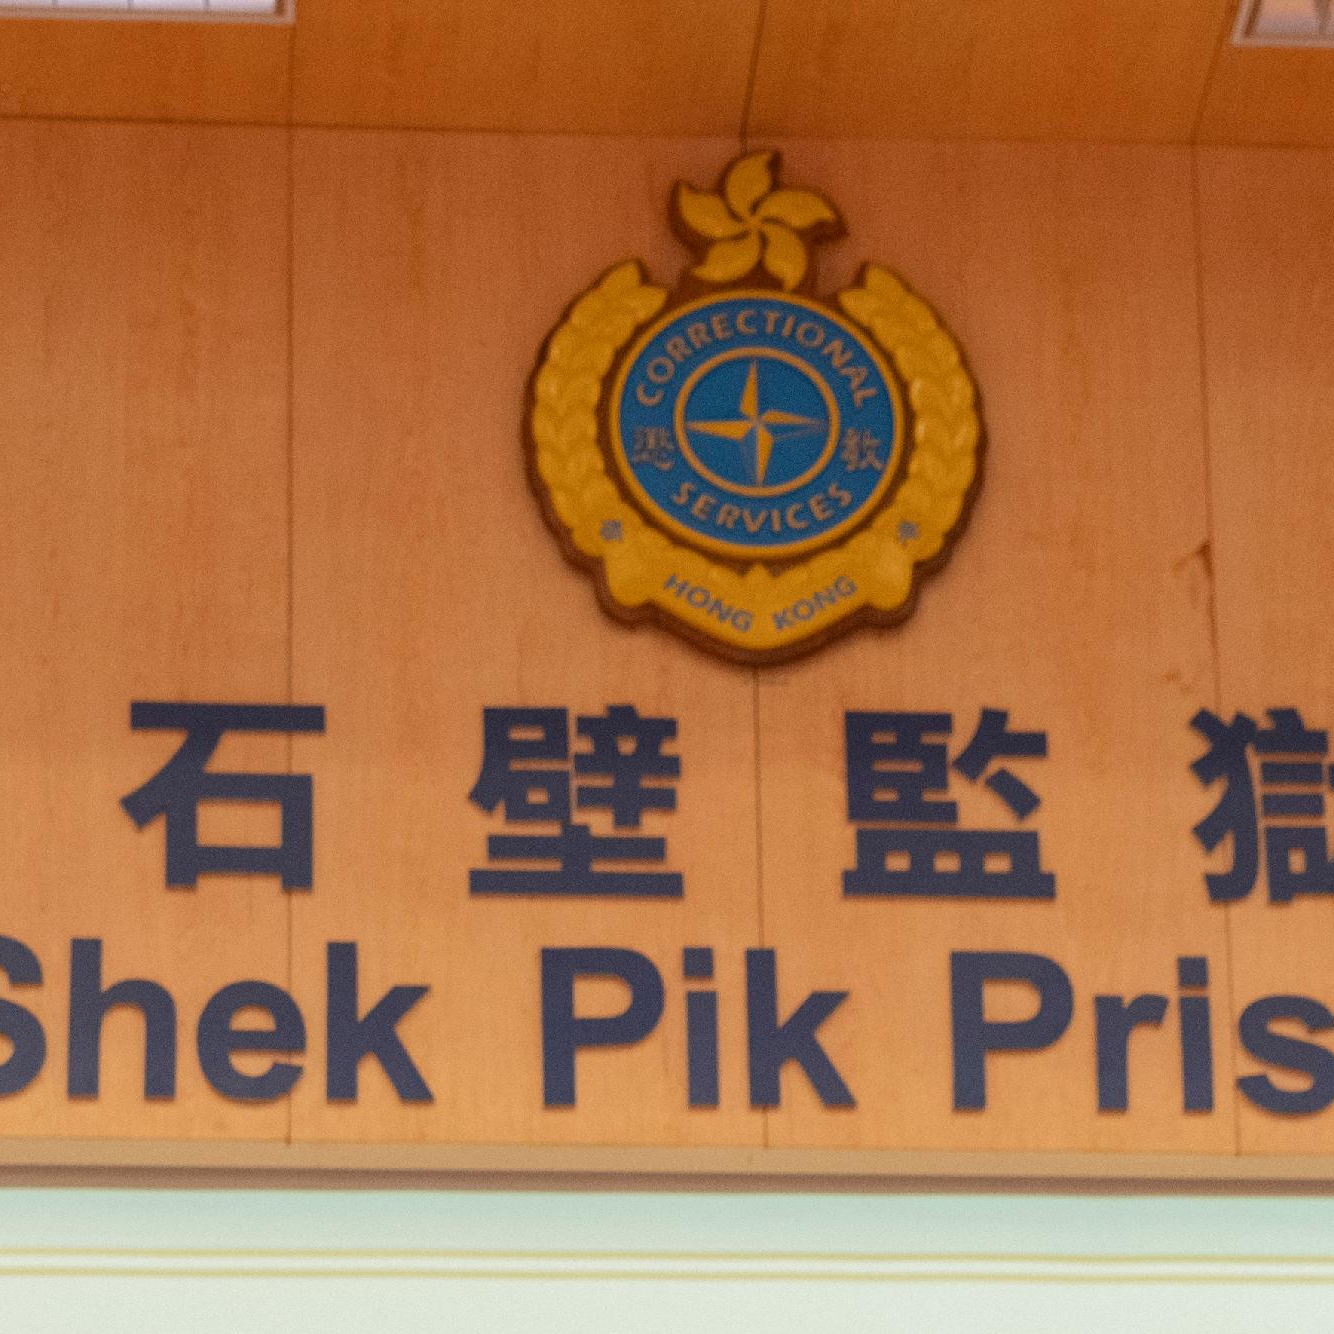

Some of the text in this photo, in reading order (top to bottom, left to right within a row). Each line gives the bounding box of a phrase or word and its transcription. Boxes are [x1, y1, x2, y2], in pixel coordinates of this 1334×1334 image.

[634, 308, 878, 408] CORRECTIONAL
[672, 481, 853, 533] SERVICES
[663, 574, 857, 633] HONG KONG
[540, 946, 855, 1109] Pik
